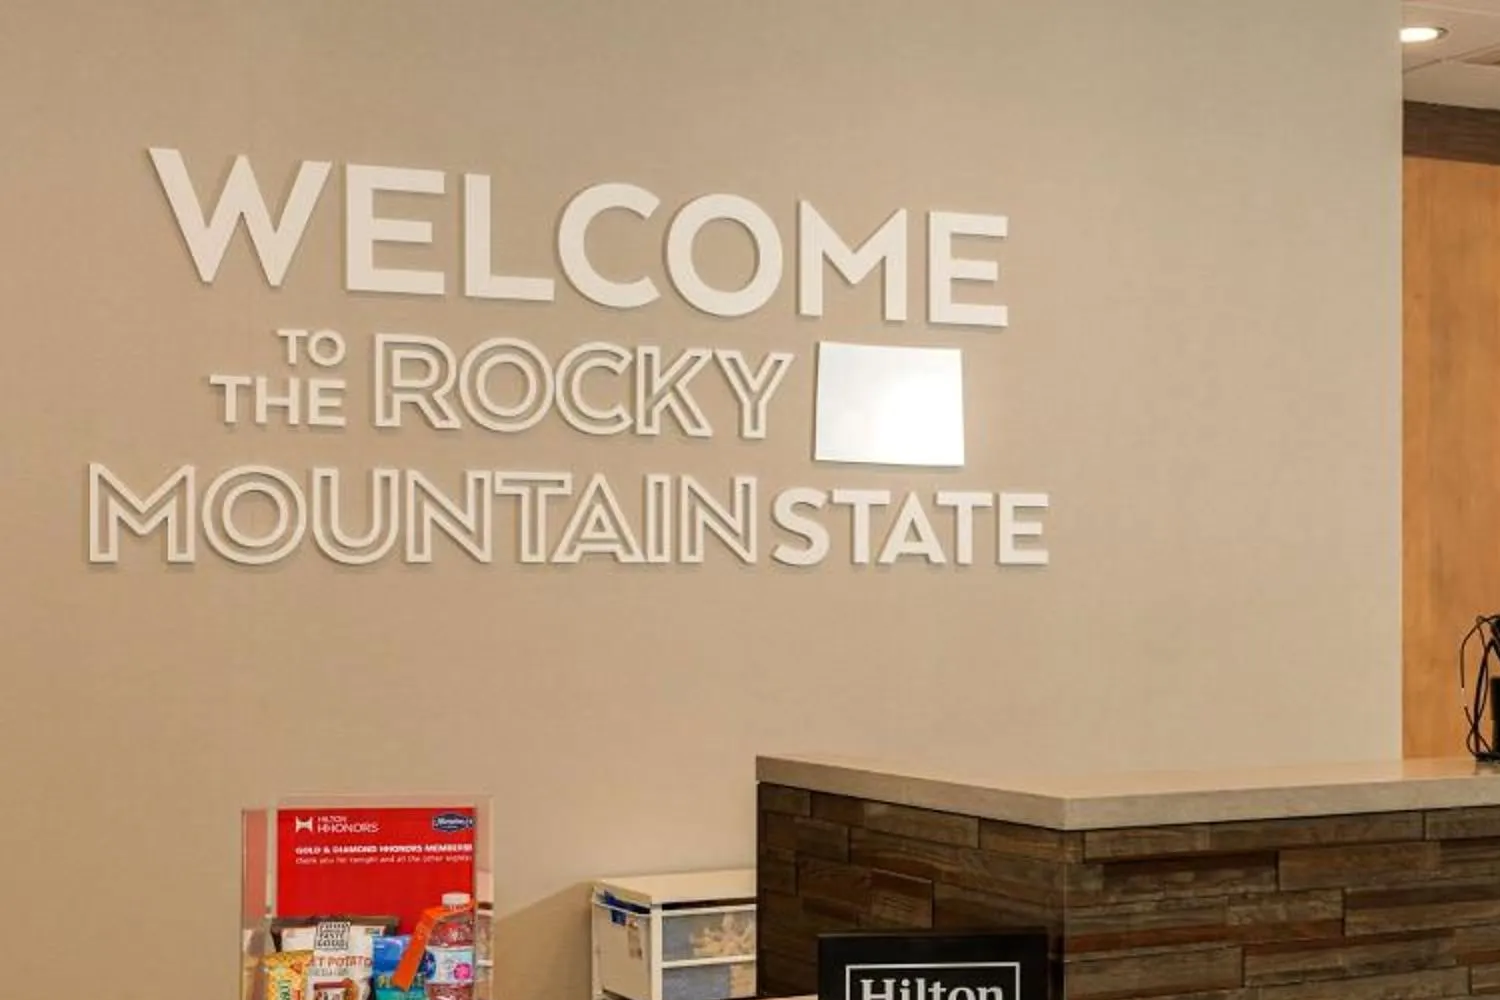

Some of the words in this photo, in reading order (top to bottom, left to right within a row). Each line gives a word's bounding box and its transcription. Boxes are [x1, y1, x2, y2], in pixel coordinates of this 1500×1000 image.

[148, 147, 1009, 328] WELCOME
[208, 374, 346, 428] THE
[373, 333, 794, 439] ROCKY
[277, 328, 346, 367] TO
[88, 462, 758, 566] MOUNTAIN
[770, 487, 1050, 567] STATE
